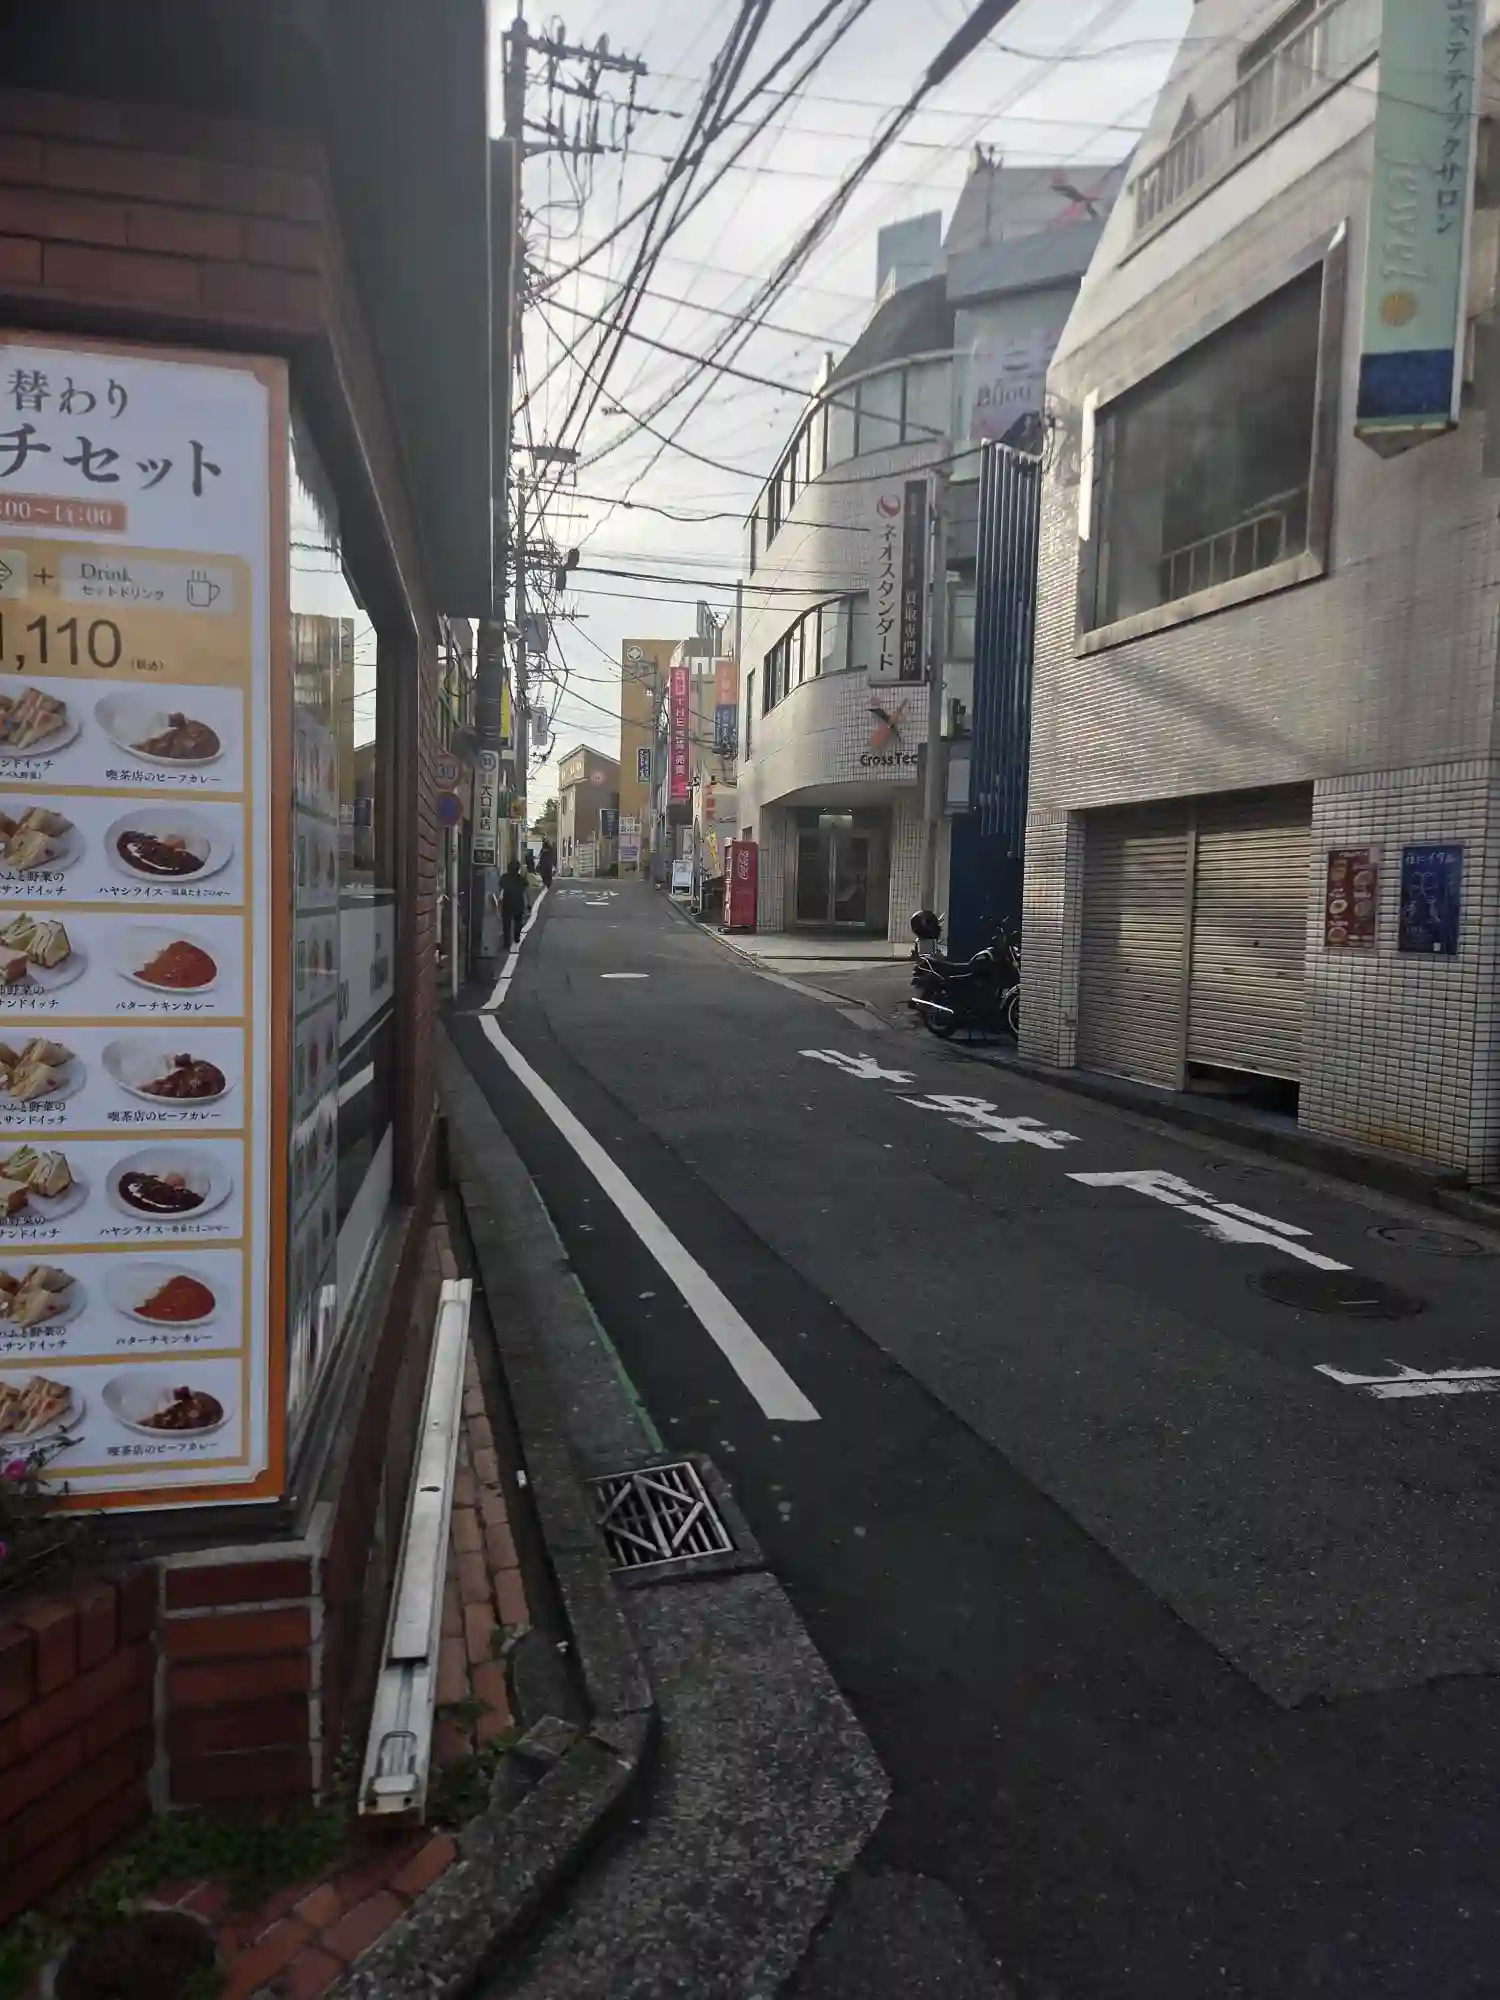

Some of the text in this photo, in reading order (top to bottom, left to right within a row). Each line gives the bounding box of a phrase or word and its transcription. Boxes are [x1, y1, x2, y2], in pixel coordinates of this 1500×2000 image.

[6, 368, 129, 421] 替わり
[876, 524, 899, 672] ネオスタンダード
[105, 769, 221, 785] 喫茶店のビーフカレー
[115, 1000, 216, 1012] バターチキンカレー
[107, 1109, 222, 1123] 喫茶店のビーフカレー
[115, 1334, 213, 1346] バターチキンカレー
[106, 1441, 219, 1457] 喫茶店のビーフカレー
